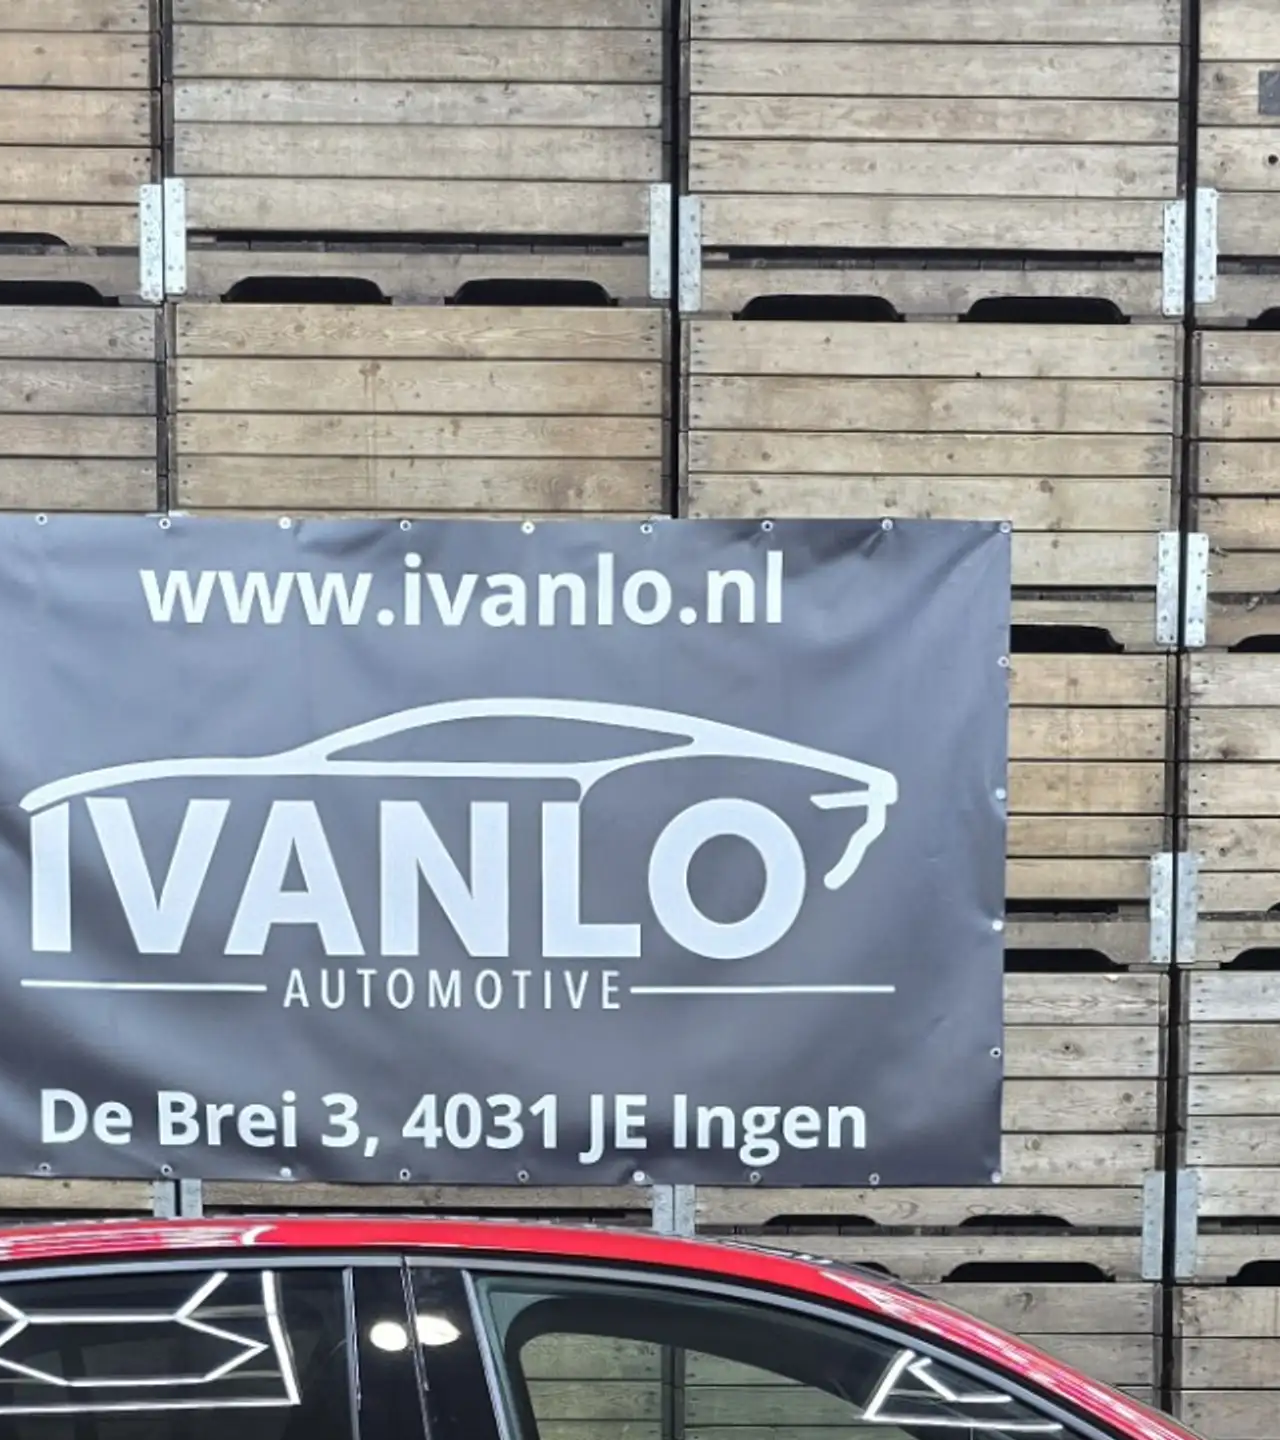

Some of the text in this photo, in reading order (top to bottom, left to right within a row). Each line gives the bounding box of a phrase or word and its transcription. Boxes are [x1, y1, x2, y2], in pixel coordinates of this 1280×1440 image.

[140, 550, 783, 628] www.ivanlo.nl
[29, 797, 807, 960] IVANLO
[283, 967, 621, 1010] AUTOMOTIVE
[41, 1089, 866, 1166] De Brei 3, 4031 JE Ingen
